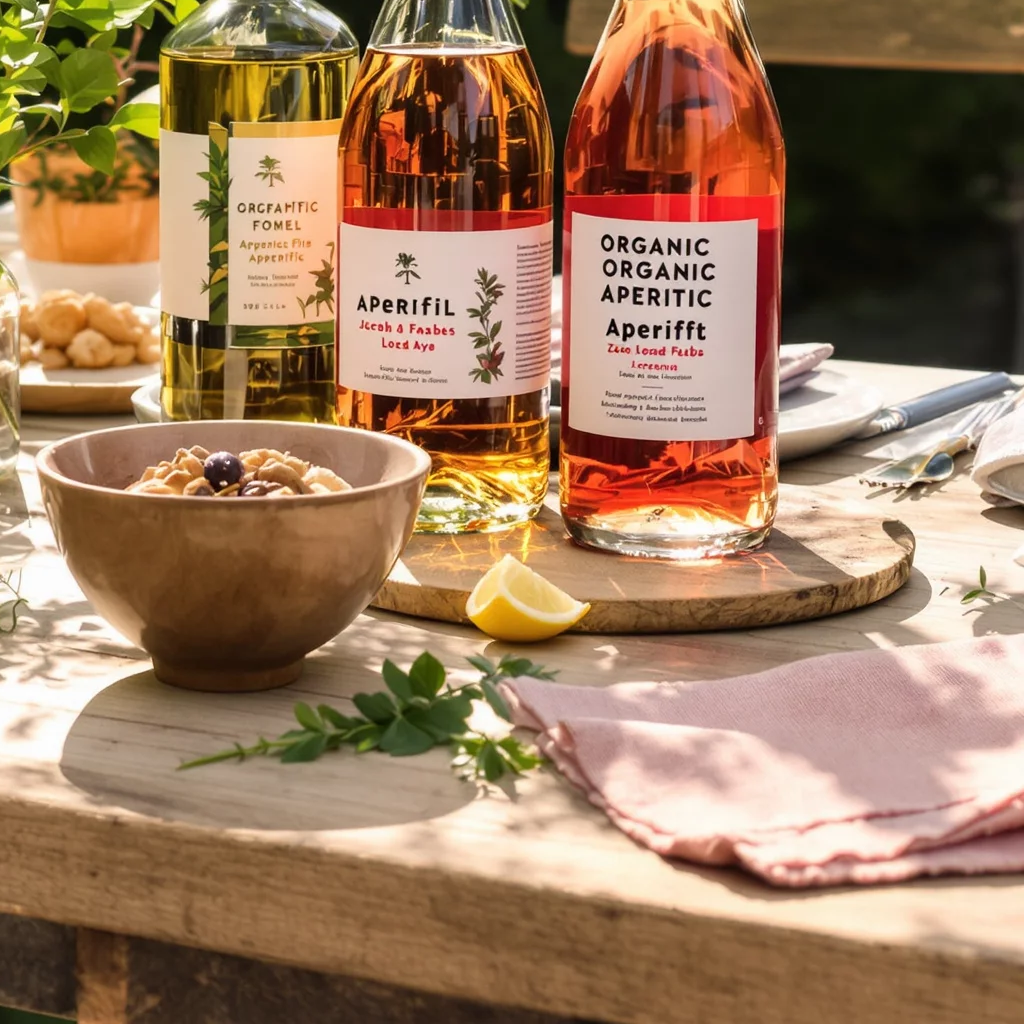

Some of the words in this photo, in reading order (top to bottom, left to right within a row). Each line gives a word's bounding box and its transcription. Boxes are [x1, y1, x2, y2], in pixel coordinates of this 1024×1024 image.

[253, 220, 301, 231] FOMEL
[600, 233, 710, 257] ORGANIC
[602, 258, 716, 282] ORGANIC
[600, 283, 713, 308] APERITIC
[605, 317, 707, 343] Aperifft
